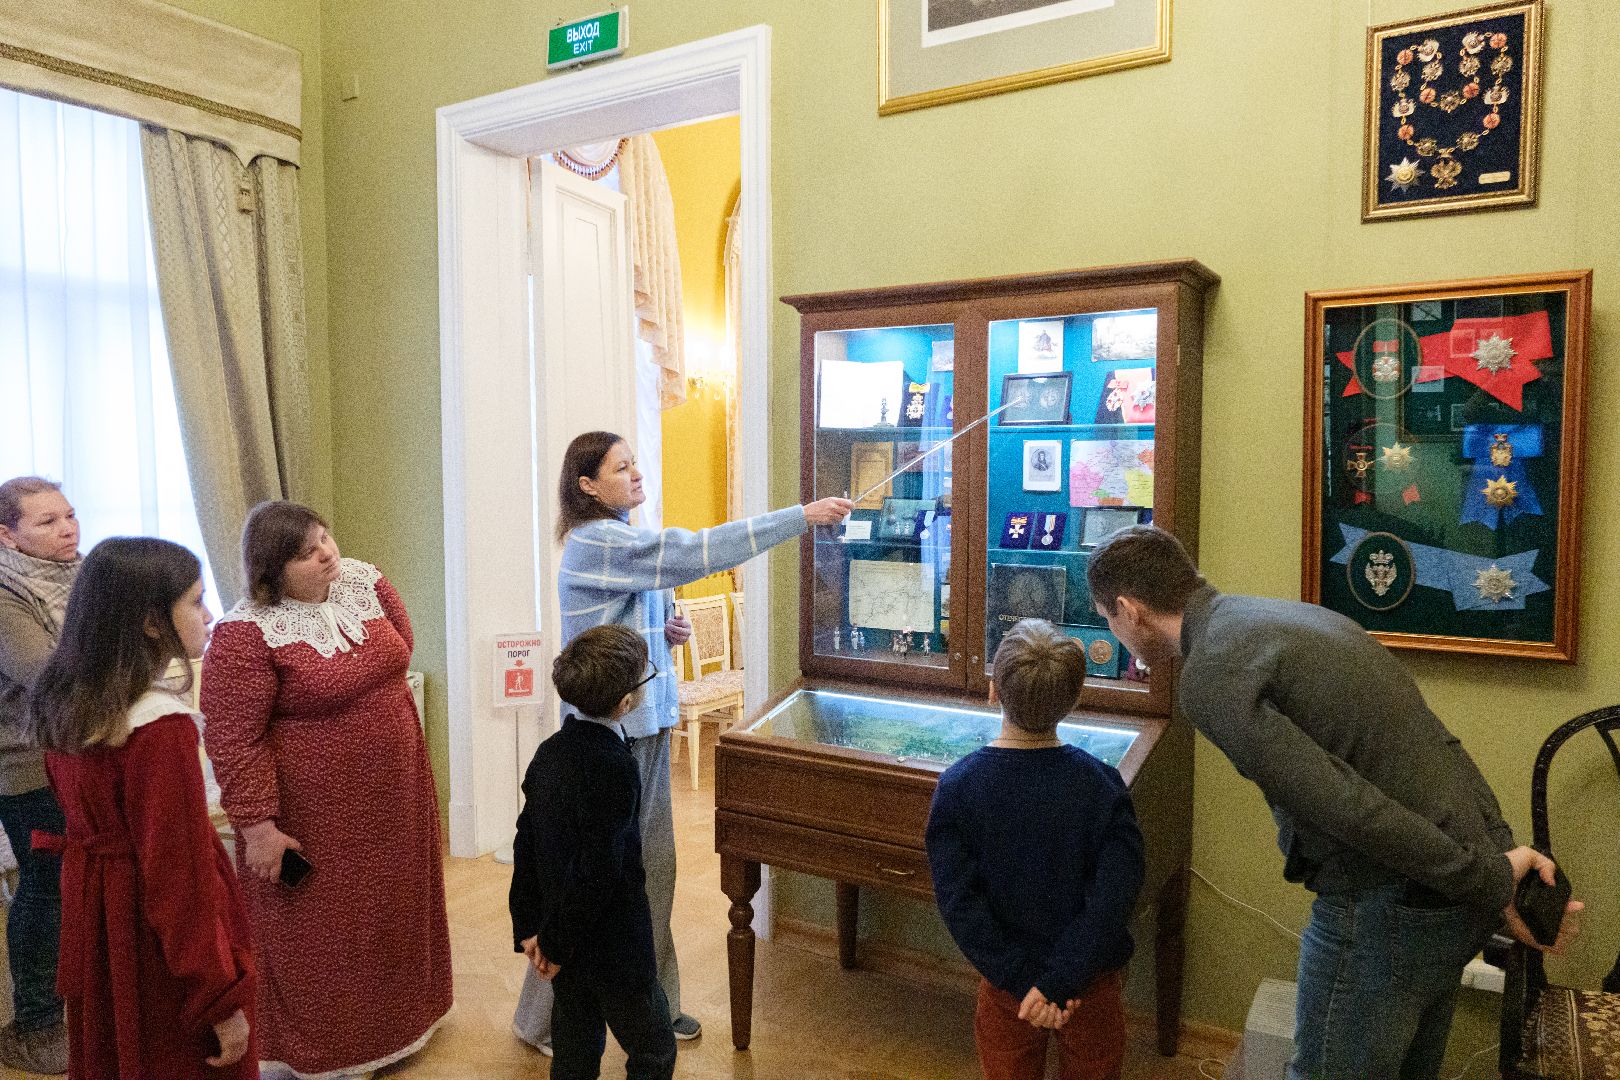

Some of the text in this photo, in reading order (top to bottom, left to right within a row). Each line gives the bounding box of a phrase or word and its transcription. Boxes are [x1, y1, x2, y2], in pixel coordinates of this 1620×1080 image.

[566, 21, 600, 43] ВЫХОД
[573, 39, 594, 55] EXIT
[497, 639, 542, 649] ОСТОРОЖНО
[507, 649, 531, 658] ПОРОГ
